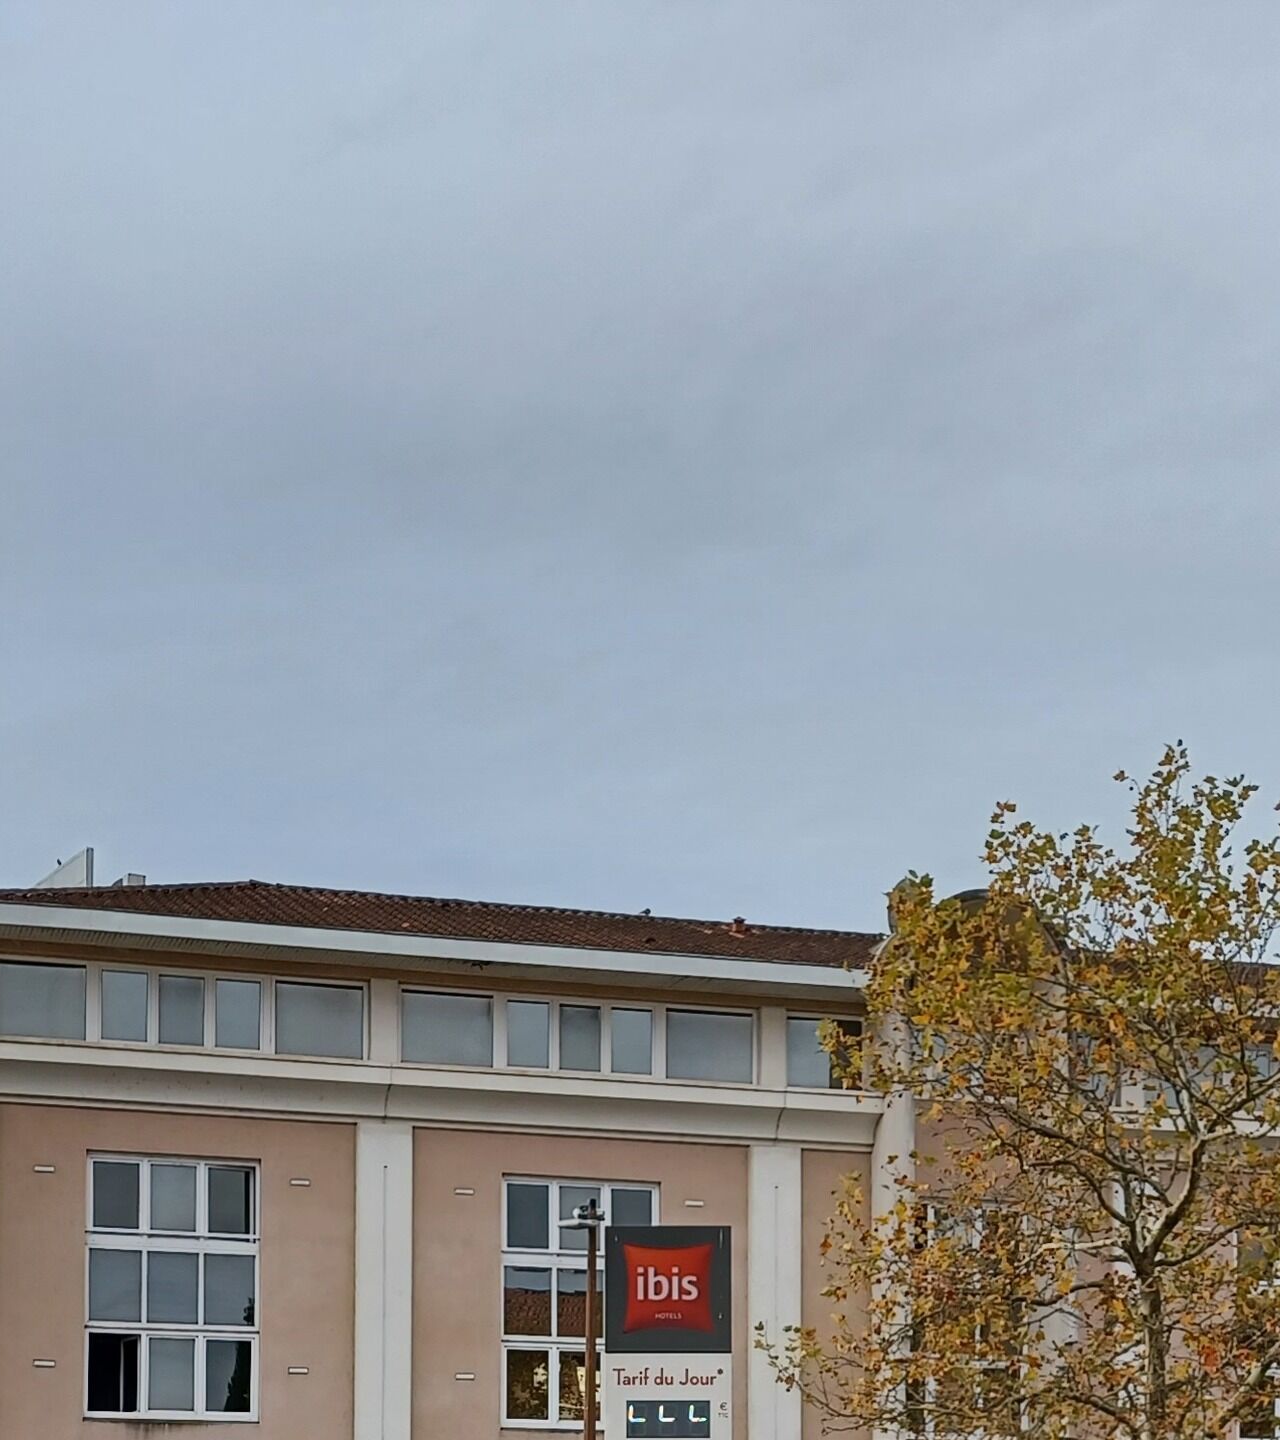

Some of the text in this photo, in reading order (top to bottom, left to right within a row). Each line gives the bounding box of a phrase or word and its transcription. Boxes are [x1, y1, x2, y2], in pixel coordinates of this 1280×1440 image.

[636, 1266, 699, 1301] ibis
[655, 1312, 682, 1320] HOTELS
[612, 1367, 650, 1386] Tarif
[654, 1367, 674, 1386] du
